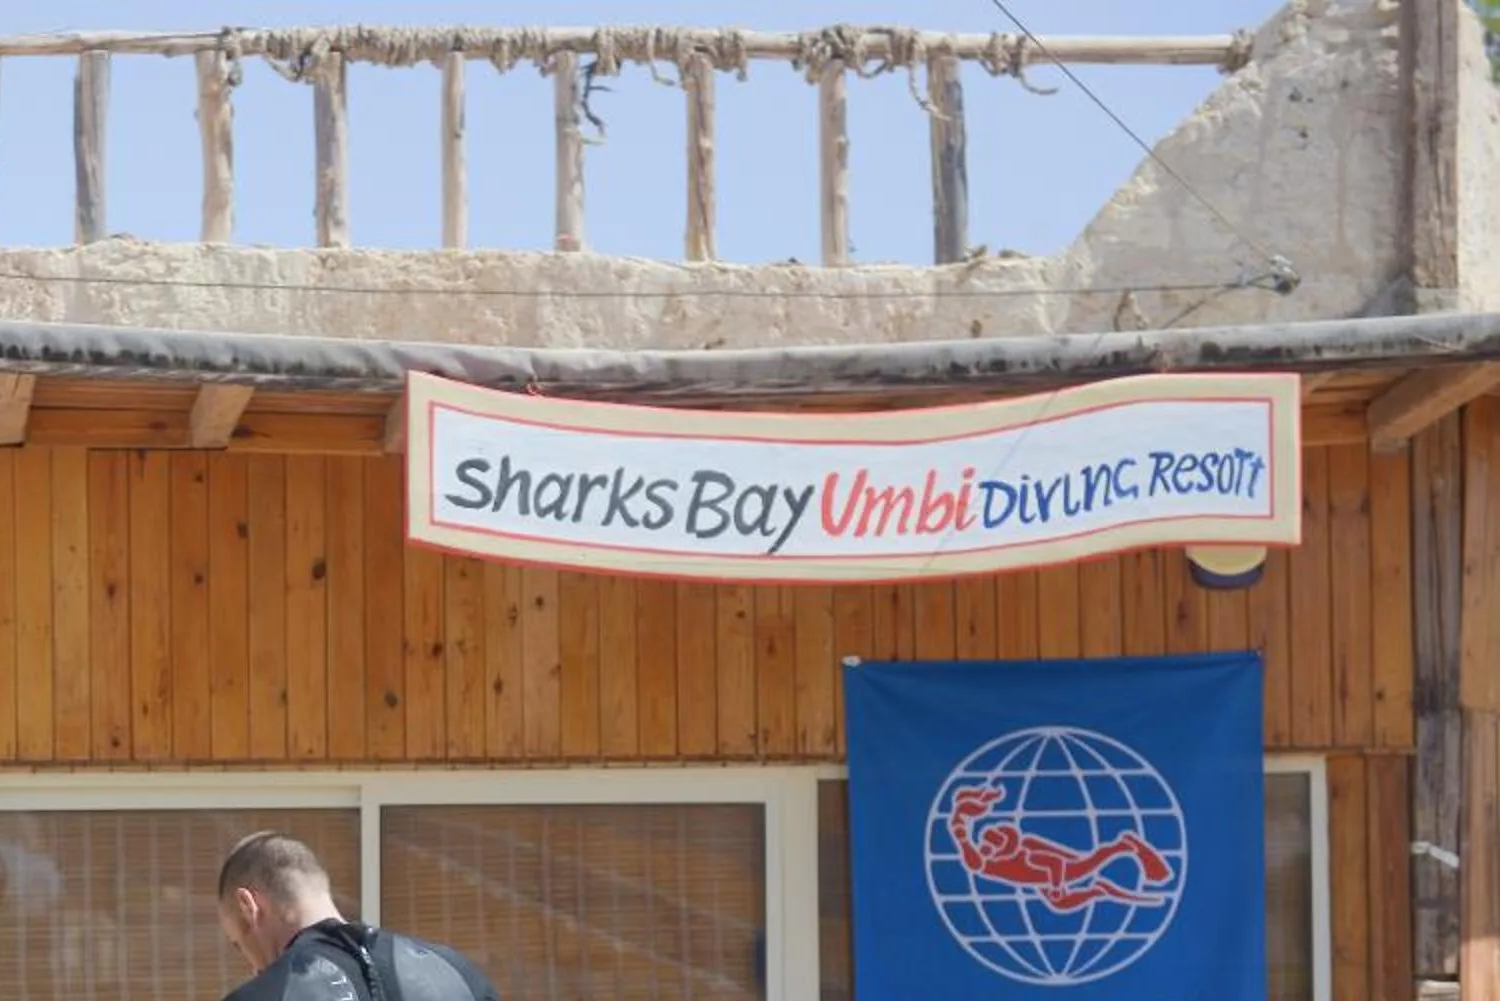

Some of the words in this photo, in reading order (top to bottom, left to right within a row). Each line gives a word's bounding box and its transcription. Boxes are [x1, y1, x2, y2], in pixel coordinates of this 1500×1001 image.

[445, 455, 680, 531] Sharks
[685, 469, 816, 555] Bay
[820, 467, 977, 539] Umbi
